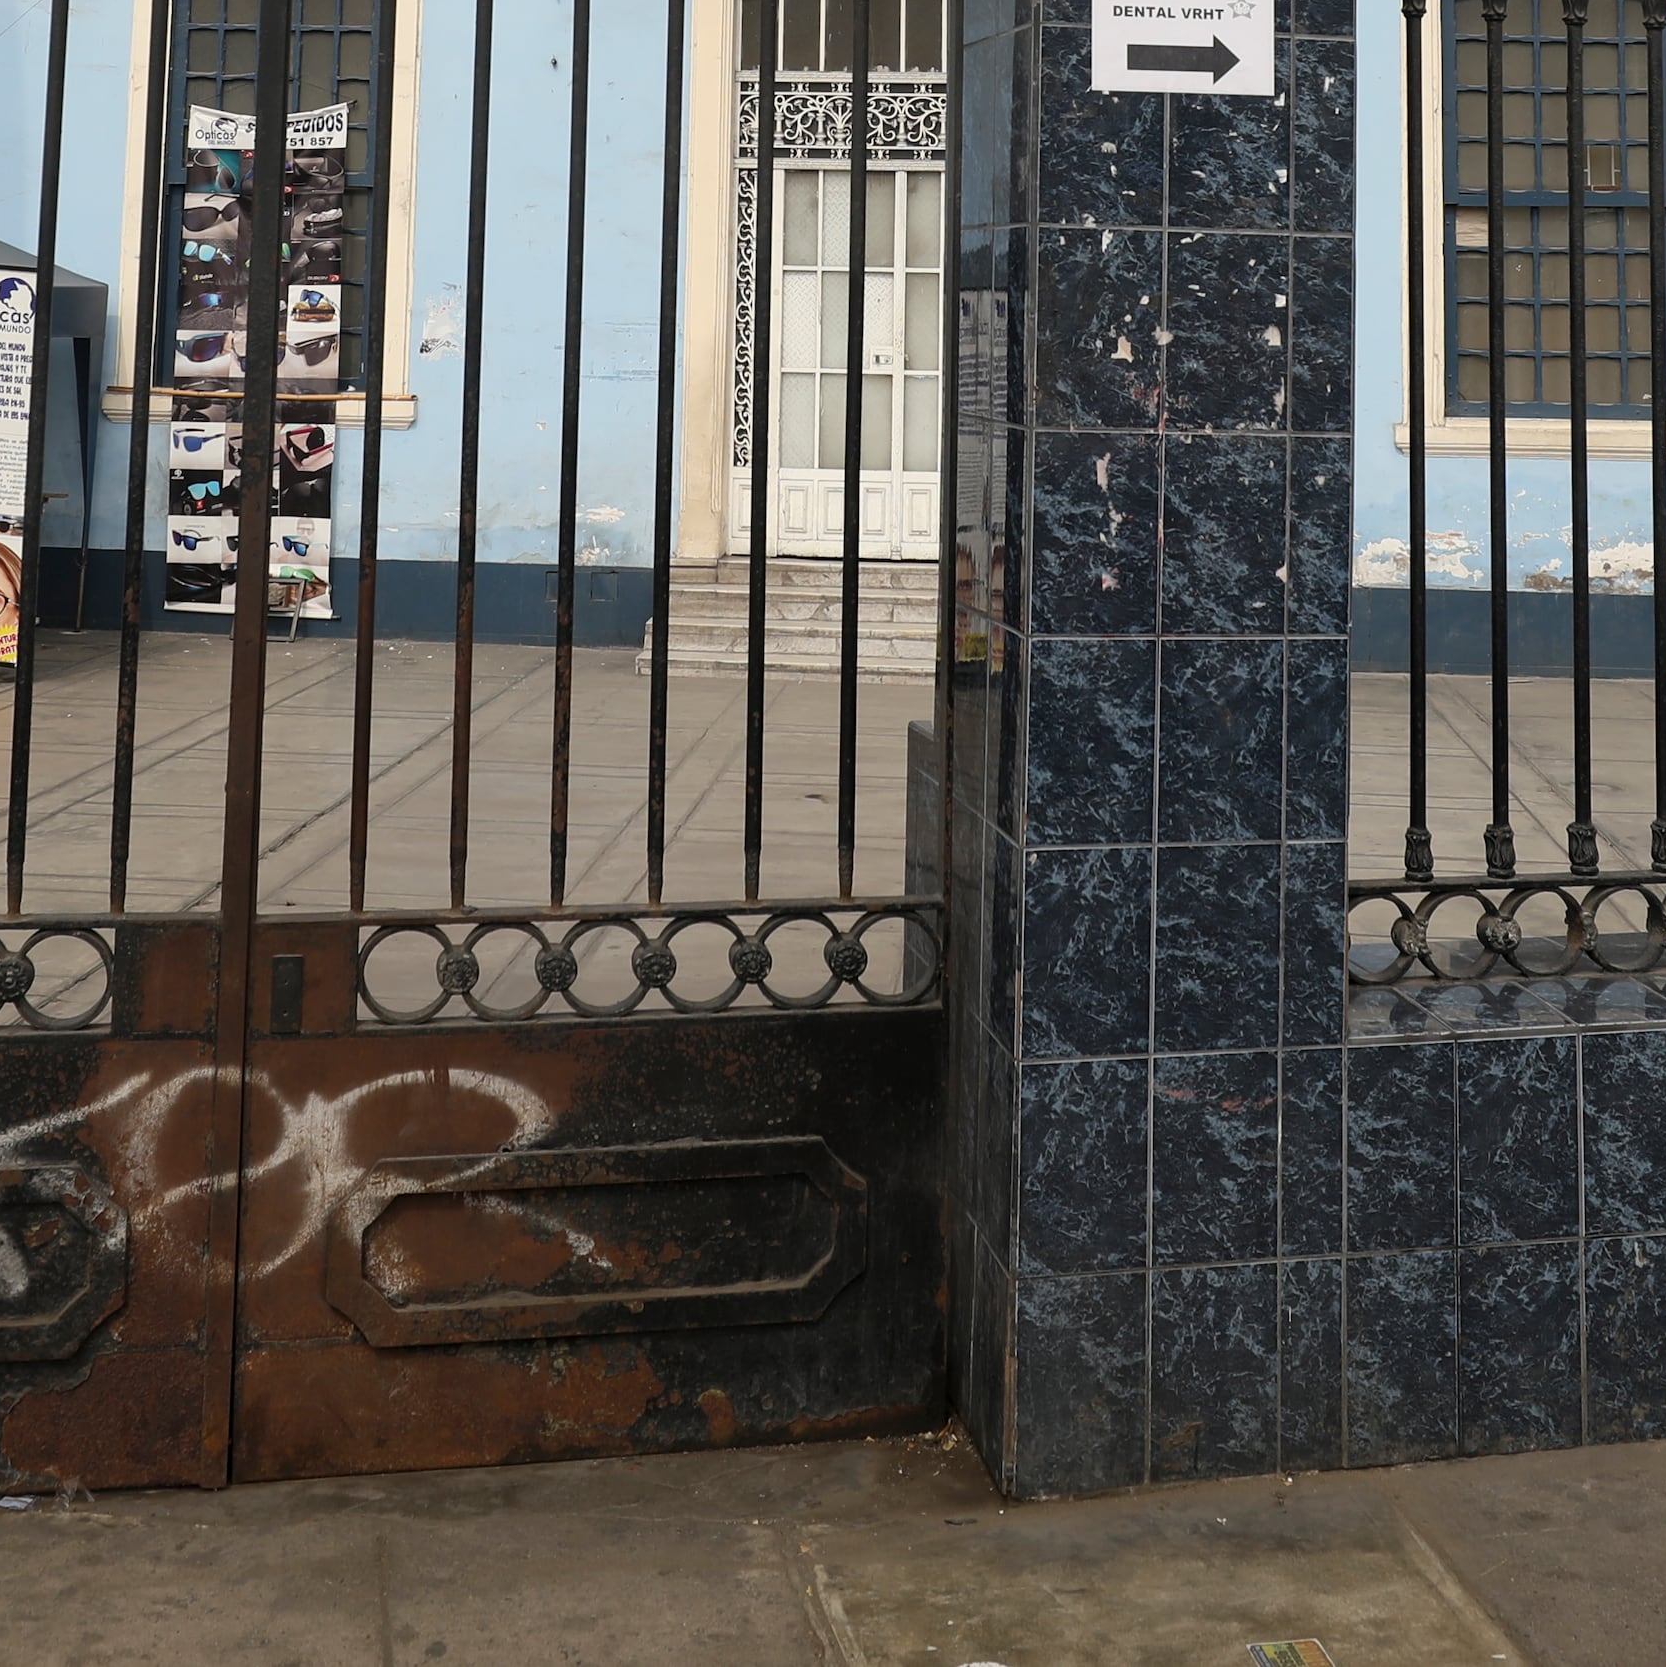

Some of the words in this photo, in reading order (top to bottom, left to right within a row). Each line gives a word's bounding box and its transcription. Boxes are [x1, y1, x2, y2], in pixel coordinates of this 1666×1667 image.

[1113, 5, 1176, 19] DENTAL
[1181, 7, 1225, 20] VRHT
[310, 136, 334, 146] 857
[0, 324, 31, 335] MUNDO
